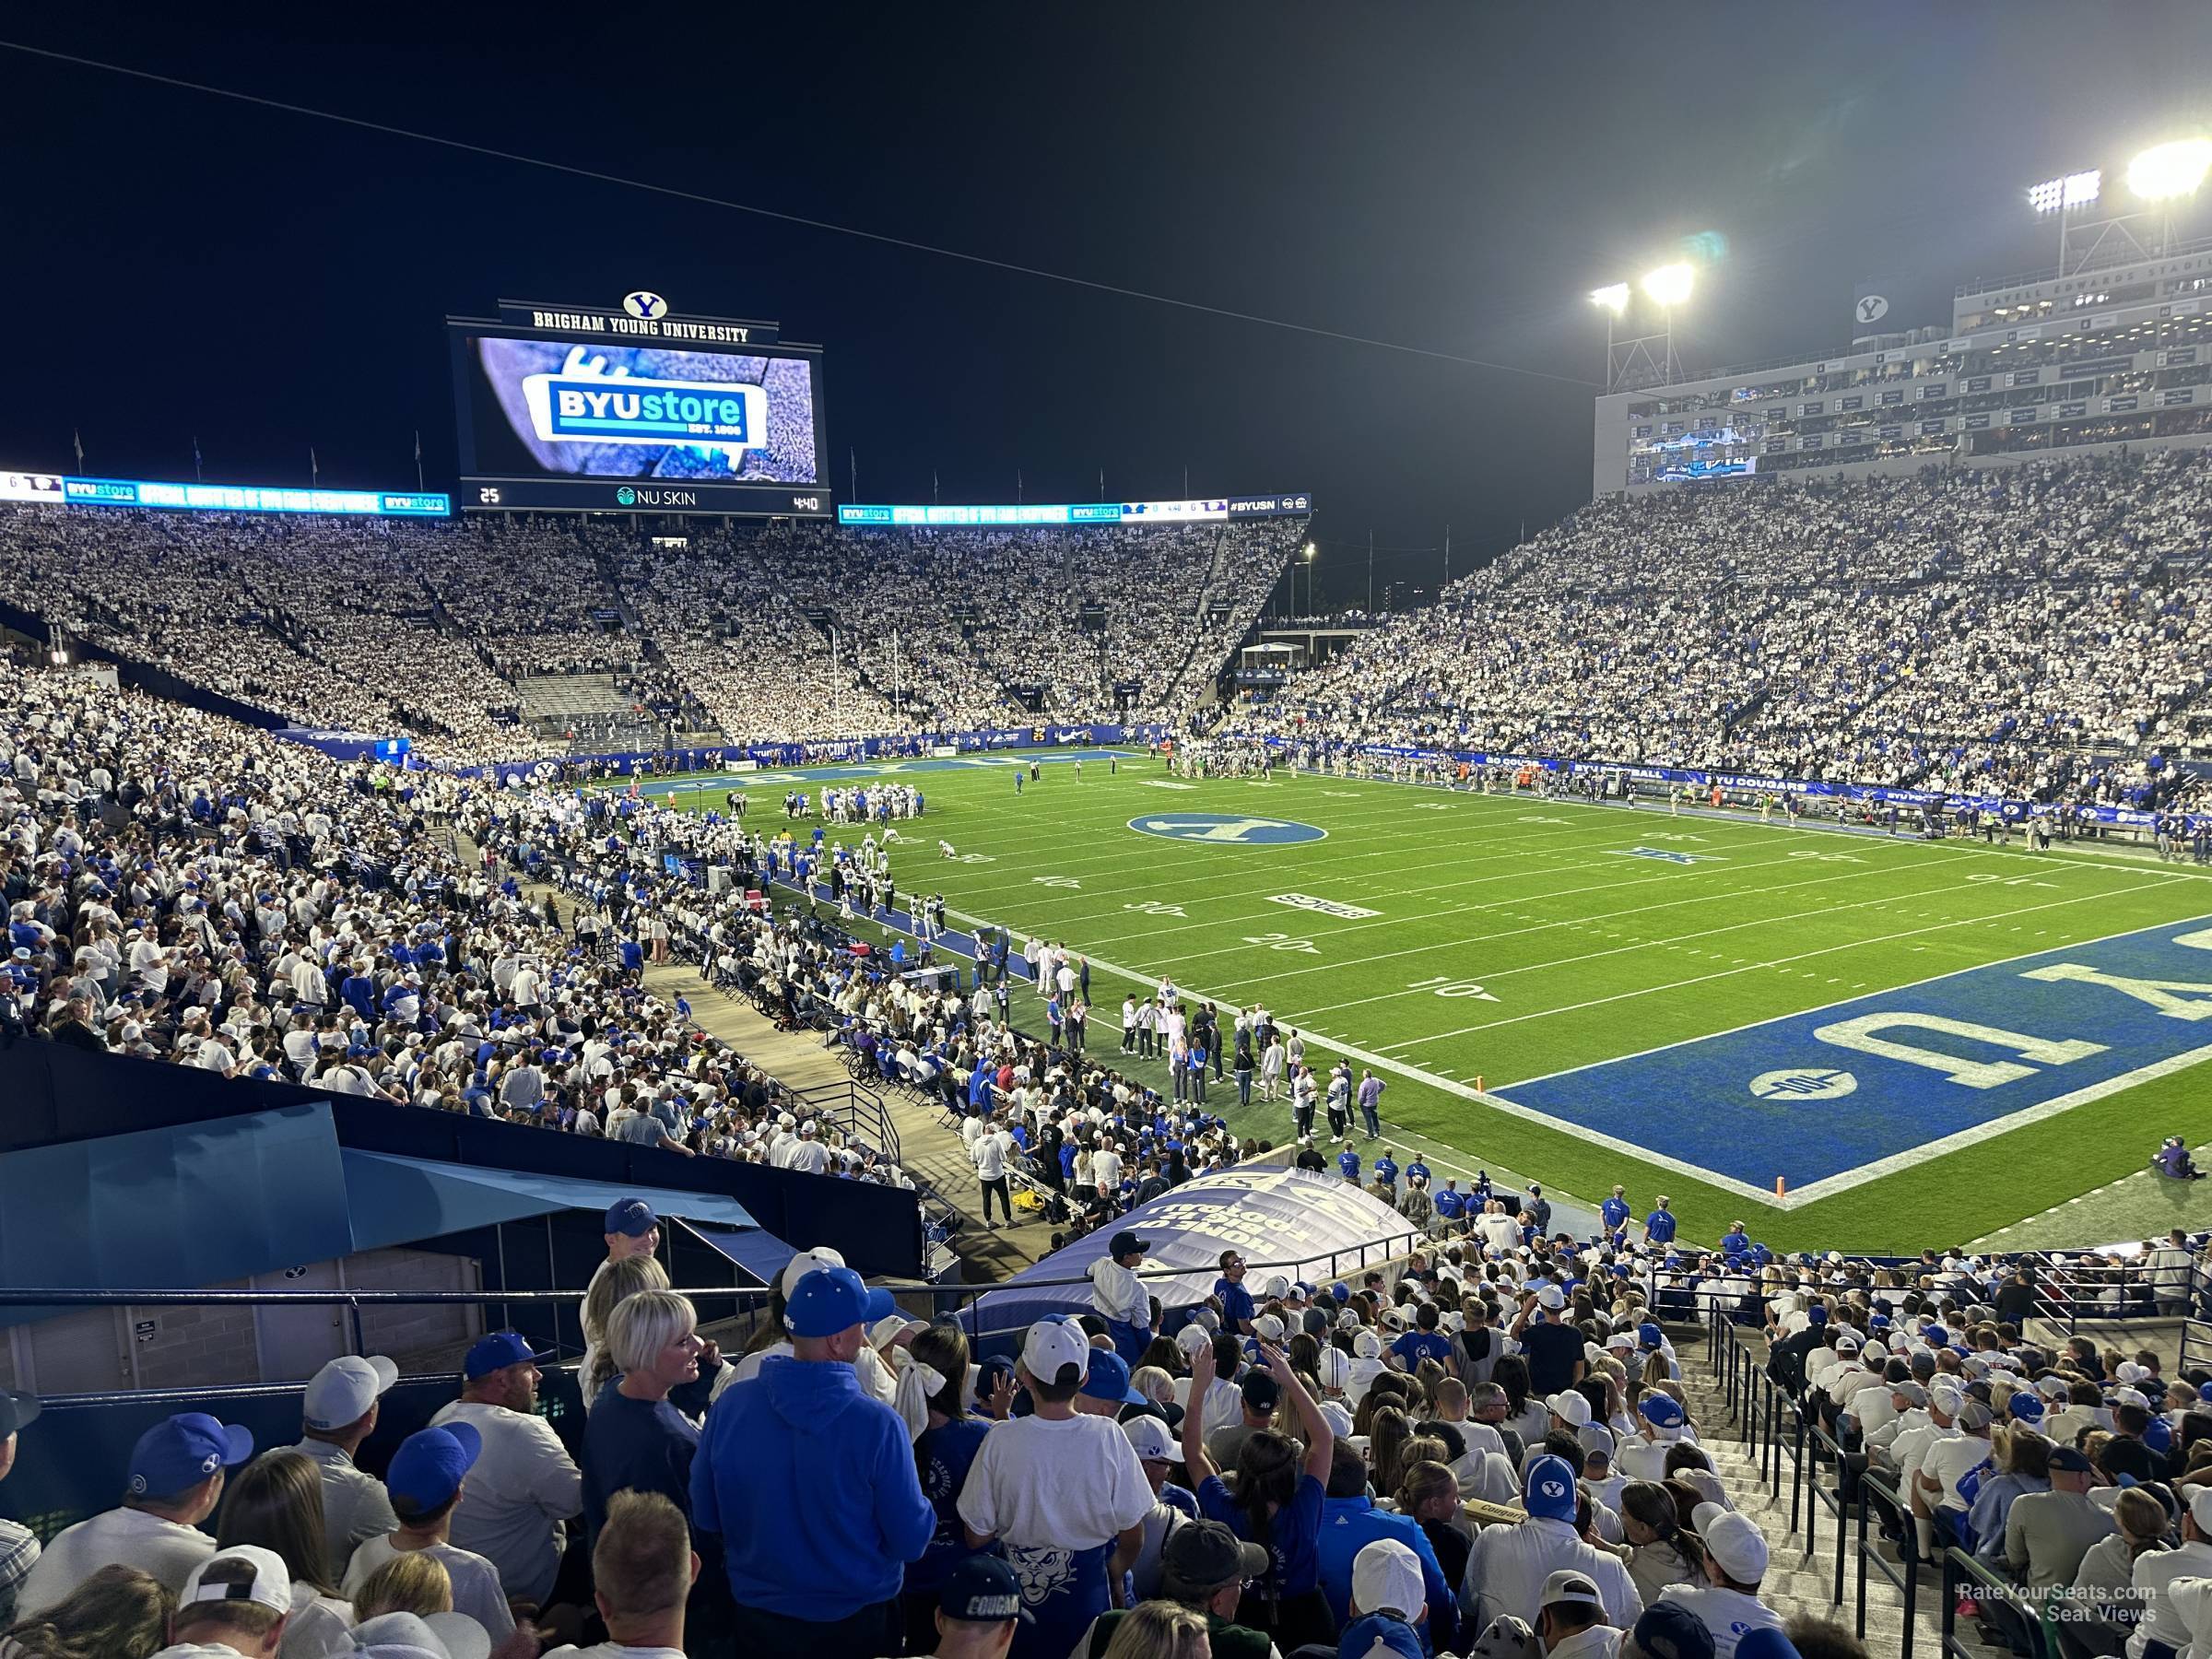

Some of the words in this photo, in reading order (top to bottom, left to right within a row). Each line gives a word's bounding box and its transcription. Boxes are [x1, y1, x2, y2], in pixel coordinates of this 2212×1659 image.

[2054, 272, 2135, 294] EDWARDS
[629, 295, 659, 318] Y
[1861, 298, 1883, 321] Y
[533, 312, 605, 333] BRIGHAM
[609, 316, 658, 336] YOUNG
[662, 322, 748, 343] UNIVERSITY
[558, 390, 740, 424] BYUstore
[480, 488, 499, 503] 25
[637, 490, 660, 505] NU
[664, 491, 696, 507] SKIN
[793, 497, 818, 511] 4:40
[1230, 500, 1276, 512] #BYUSN
[1033, 732, 1045, 741] 25
[1486, 757, 1501, 765] GO
[1575, 764, 1598, 772] BYU
[1735, 778, 1807, 793] COUGARS
[1123, 900, 1177, 915] 30
[1241, 933, 1312, 952] 20
[1406, 977, 1484, 998] 10
[1147, 1202, 1312, 1243] FOOTBALL
[1202, 1212, 1266, 1236] BIG
[1170, 1219, 1278, 1256] HOME
[1544, 1483, 1562, 1498] Y
